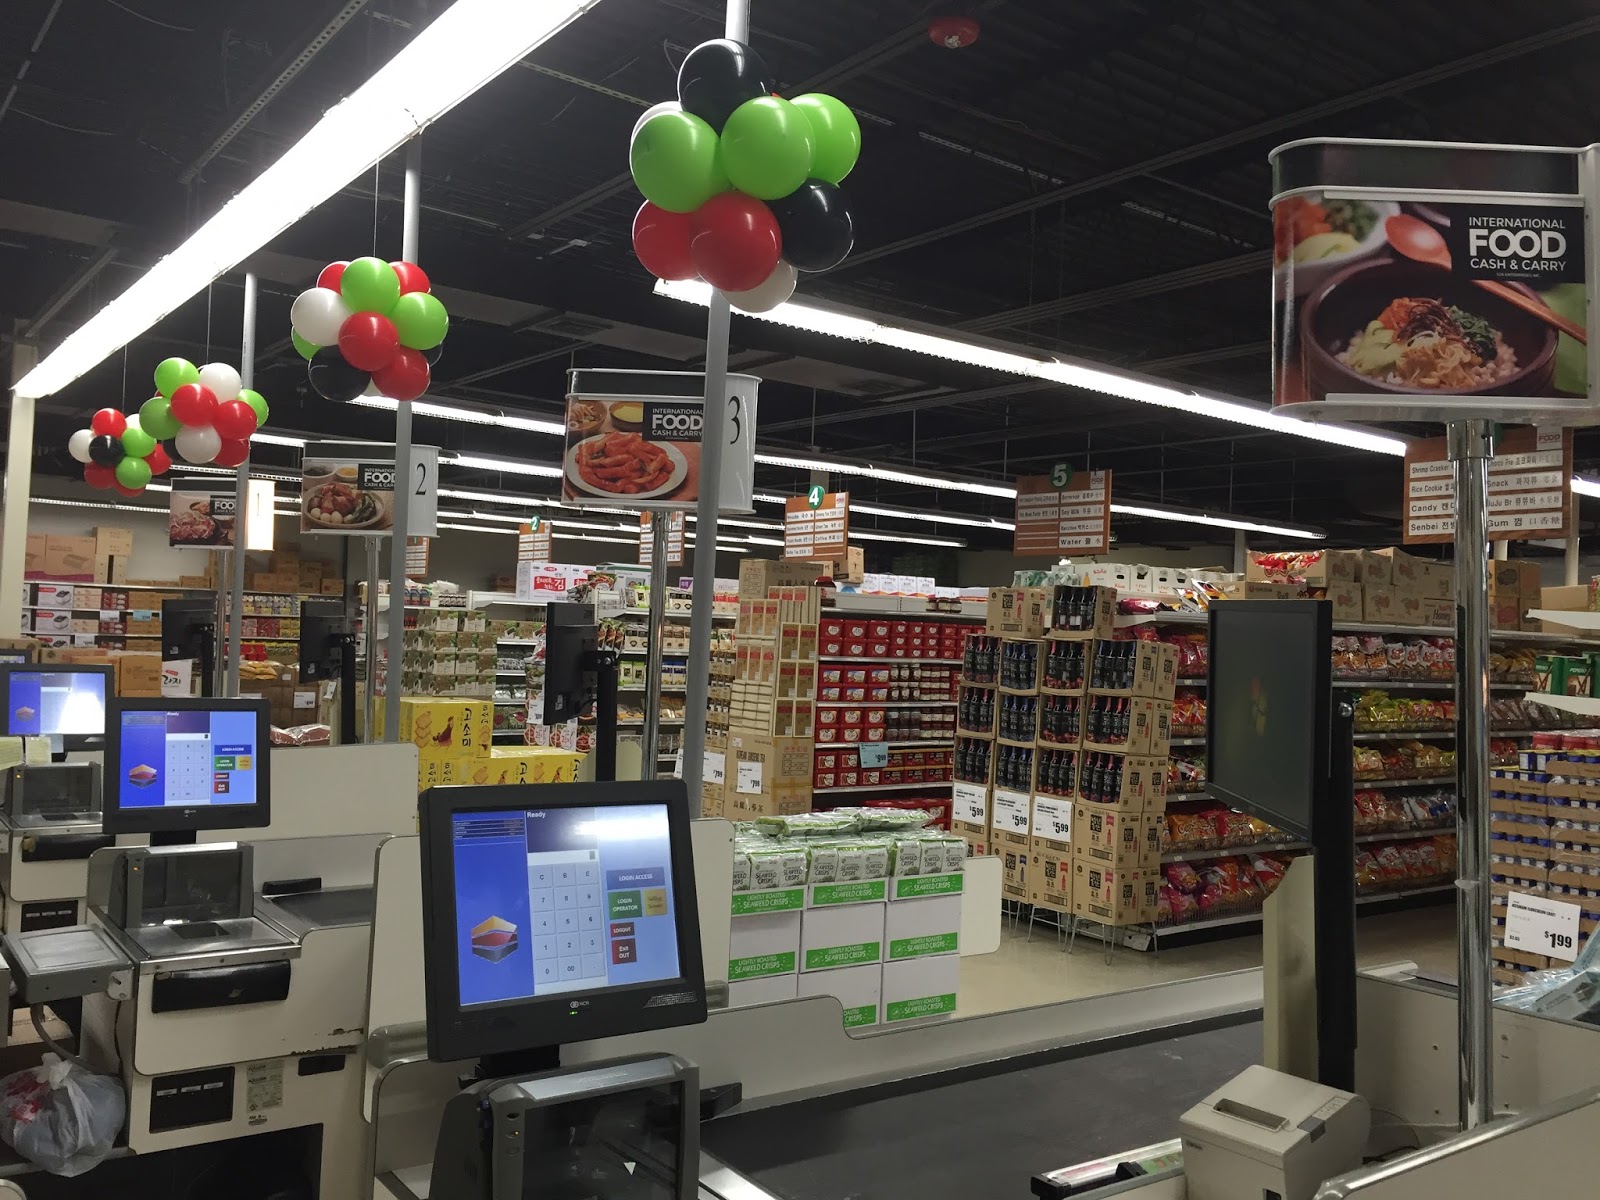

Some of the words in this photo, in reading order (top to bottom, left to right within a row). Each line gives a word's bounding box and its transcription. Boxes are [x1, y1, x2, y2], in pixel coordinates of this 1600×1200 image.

[1469, 216, 1566, 229] INTERNATIONAL
[1469, 228, 1566, 258] FOOD
[1470, 258, 1506, 270] CASH
[1510, 259, 1518, 270] &
[1522, 260, 1566, 272] CARRY
[652, 414, 704, 430] FOOD
[728, 396, 740, 445] 3
[415, 462, 427, 496] 2
[1052, 464, 1067, 487] 5
[808, 487, 819, 506] 4
[214, 501, 236, 510] FOO
[531, 518, 538, 531] 2
[462, 707, 472, 748] 고소미
[969, 805, 984, 818] $599
[1012, 814, 1028, 826] $599
[1052, 821, 1069, 834] $599
[743, 900, 769, 908] SEAWEED
[1544, 930, 1572, 948] $199
[907, 943, 930, 952] SEAWEED
[825, 953, 849, 962] SEAWEED
[849, 951, 866, 959] CRISPS
[735, 964, 760, 973] SEAWEED
[761, 962, 780, 970] CRISPS
[904, 1005, 927, 1014] SEAWEED
[845, 1014, 862, 1022] CRISPS
